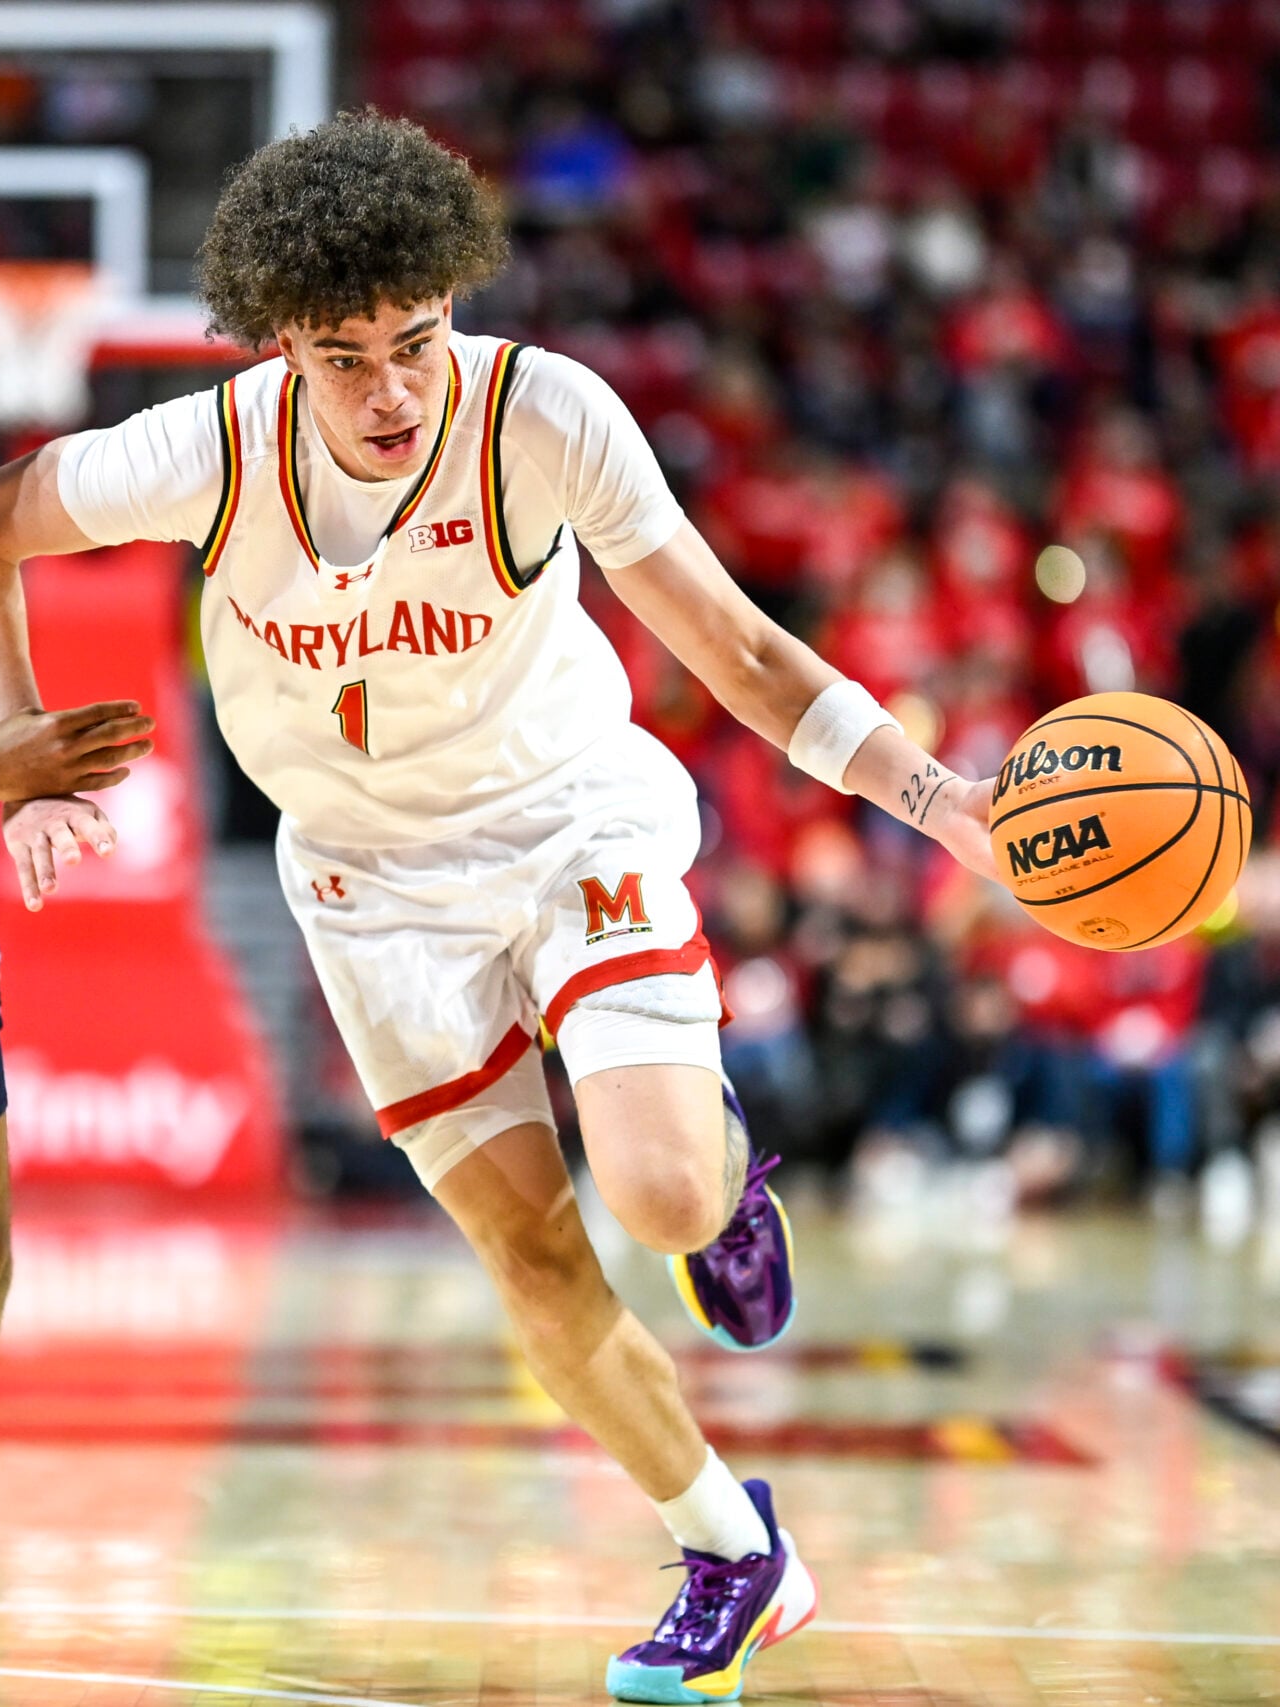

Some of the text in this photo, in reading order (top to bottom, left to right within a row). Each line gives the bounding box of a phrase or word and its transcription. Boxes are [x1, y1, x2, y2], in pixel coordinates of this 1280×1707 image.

[227, 595, 493, 671] MARYLAND
[331, 679, 370, 757] 1
[901, 763, 939, 818] 224
[992, 741, 1122, 807] Wilson
[1006, 814, 1111, 878] NCAA
[577, 872, 651, 937] M
